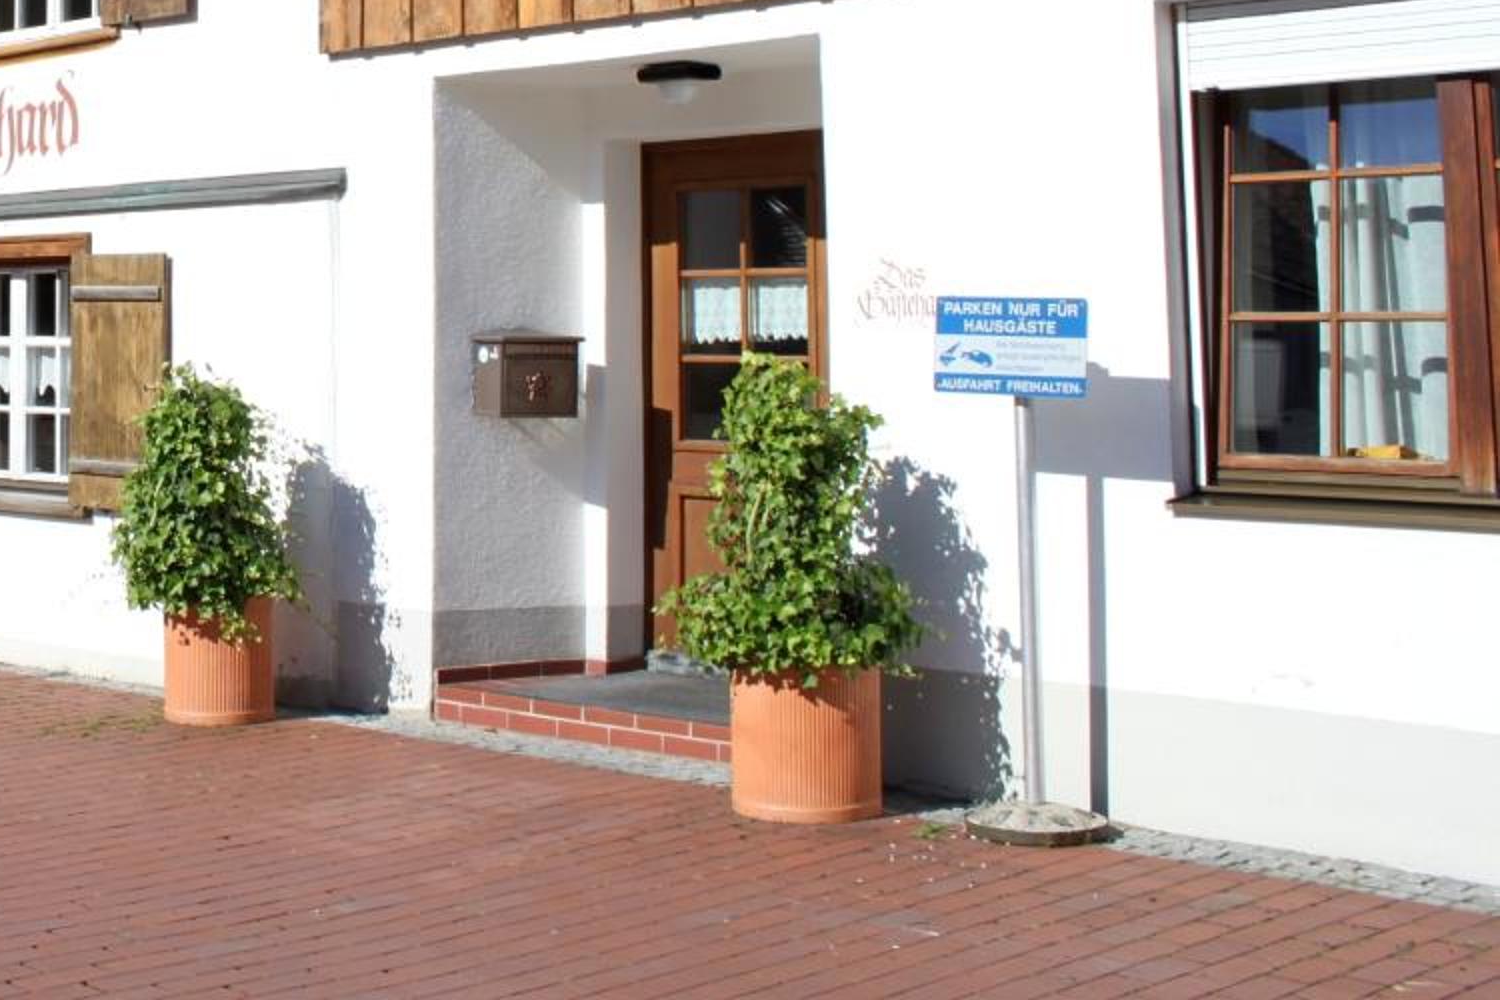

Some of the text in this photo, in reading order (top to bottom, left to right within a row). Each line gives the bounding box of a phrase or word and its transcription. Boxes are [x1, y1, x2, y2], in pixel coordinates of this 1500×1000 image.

[943, 299, 1079, 318] PARKEN NUR FÜR
[963, 315, 1057, 335] HAUSGÄSTE
[940, 378, 1001, 392] AUSFAHRT
